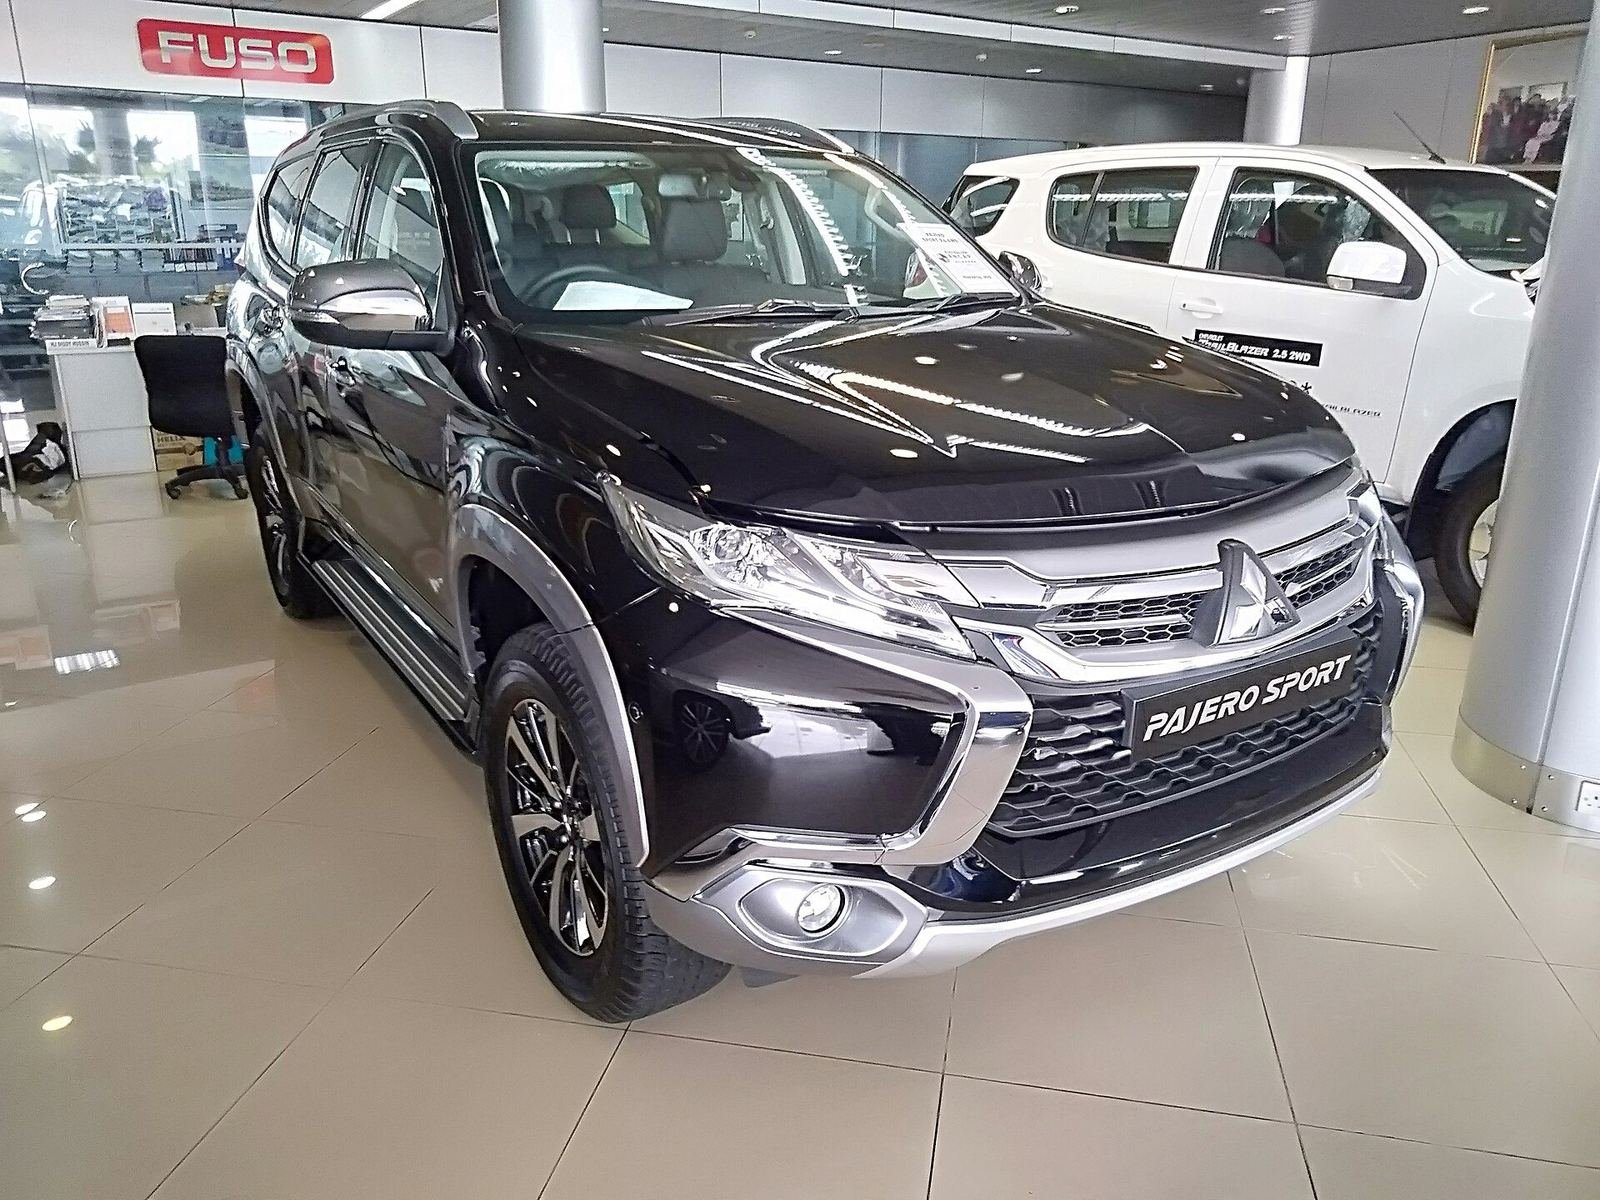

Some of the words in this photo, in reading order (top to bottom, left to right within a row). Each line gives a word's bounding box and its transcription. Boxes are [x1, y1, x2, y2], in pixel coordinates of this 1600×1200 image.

[157, 31, 317, 73] FUSO
[1272, 348, 1288, 359] 2.5
[1289, 350, 1312, 362] 2WD
[1142, 685, 1261, 742] PAJERO
[1261, 655, 1351, 704] SPORT
